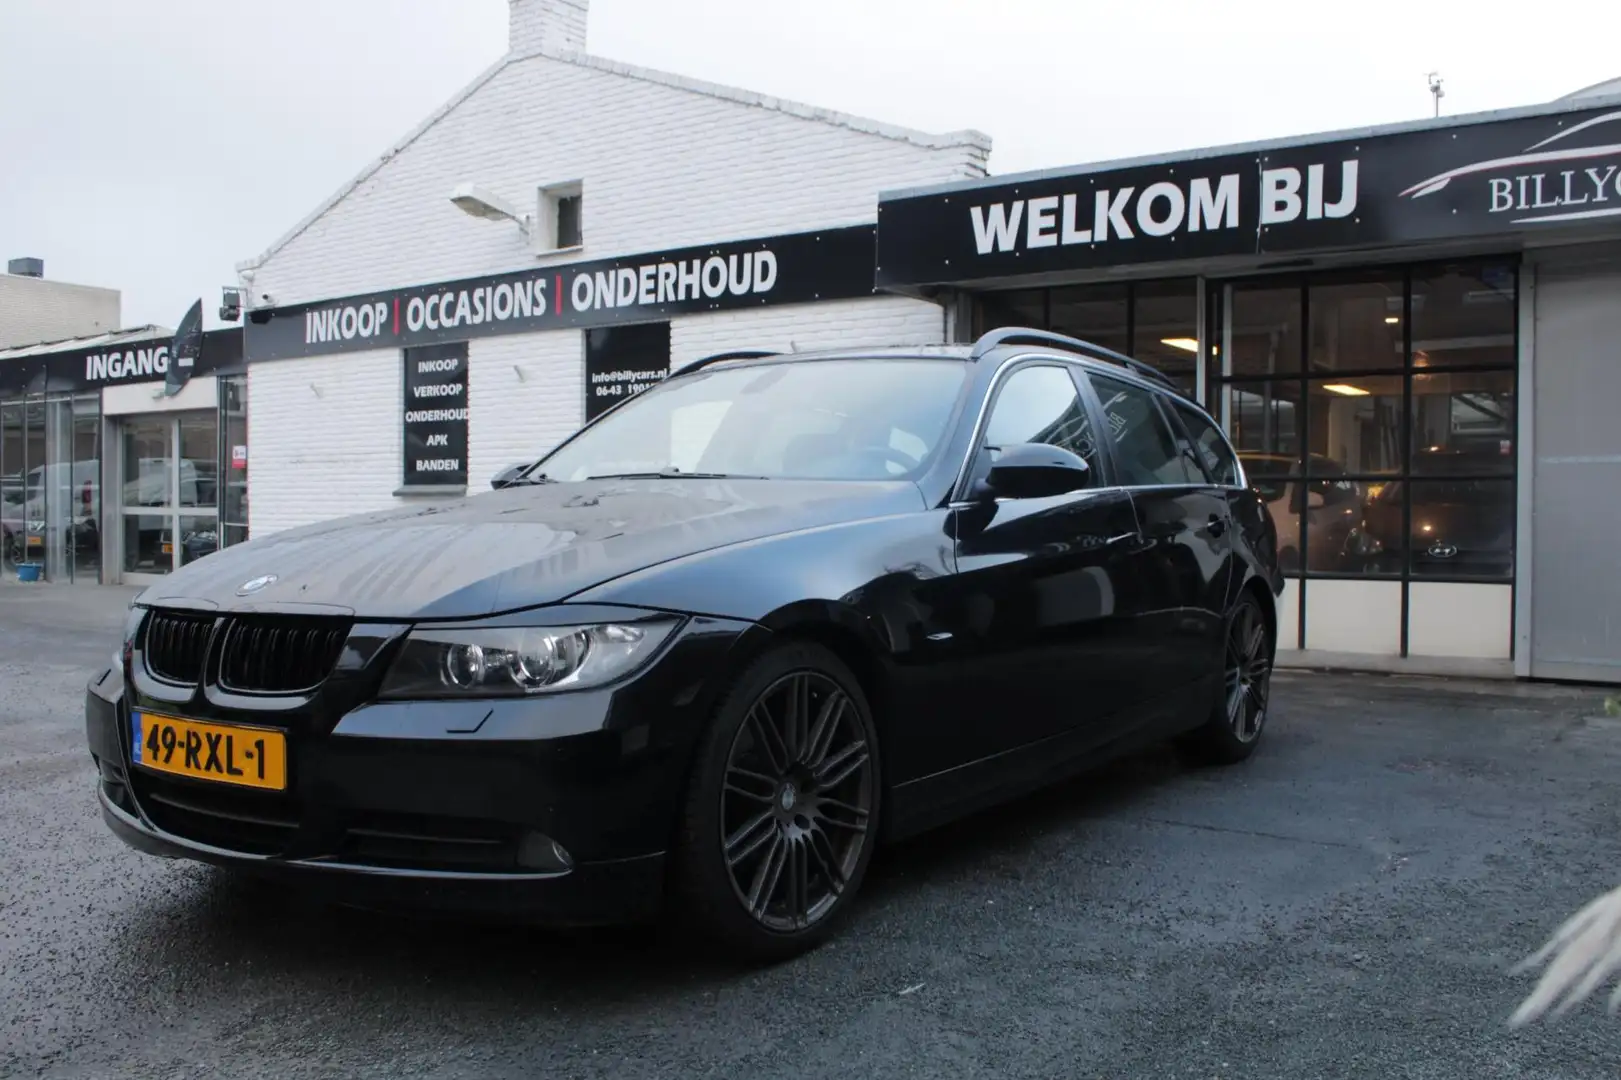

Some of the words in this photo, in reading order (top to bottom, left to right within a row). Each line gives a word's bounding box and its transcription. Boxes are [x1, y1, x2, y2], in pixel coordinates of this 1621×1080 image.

[1488, 165, 1621, 212] BILLY
[970, 173, 1240, 255] WELKOM
[1261, 160, 1359, 226] BIJ
[305, 302, 387, 343] INKOOP
[406, 278, 547, 332] OCCASIONS
[571, 250, 778, 312] ONDERHOUD
[86, 346, 168, 381] INGANG
[418, 359, 459, 373] INKOOP
[413, 383, 463, 398] VERKOOP
[596, 385, 622, 396] 06-43
[426, 434, 448, 446] APK
[416, 459, 459, 471] BANDEN
[146, 723, 265, 780] 49-RXL-1
